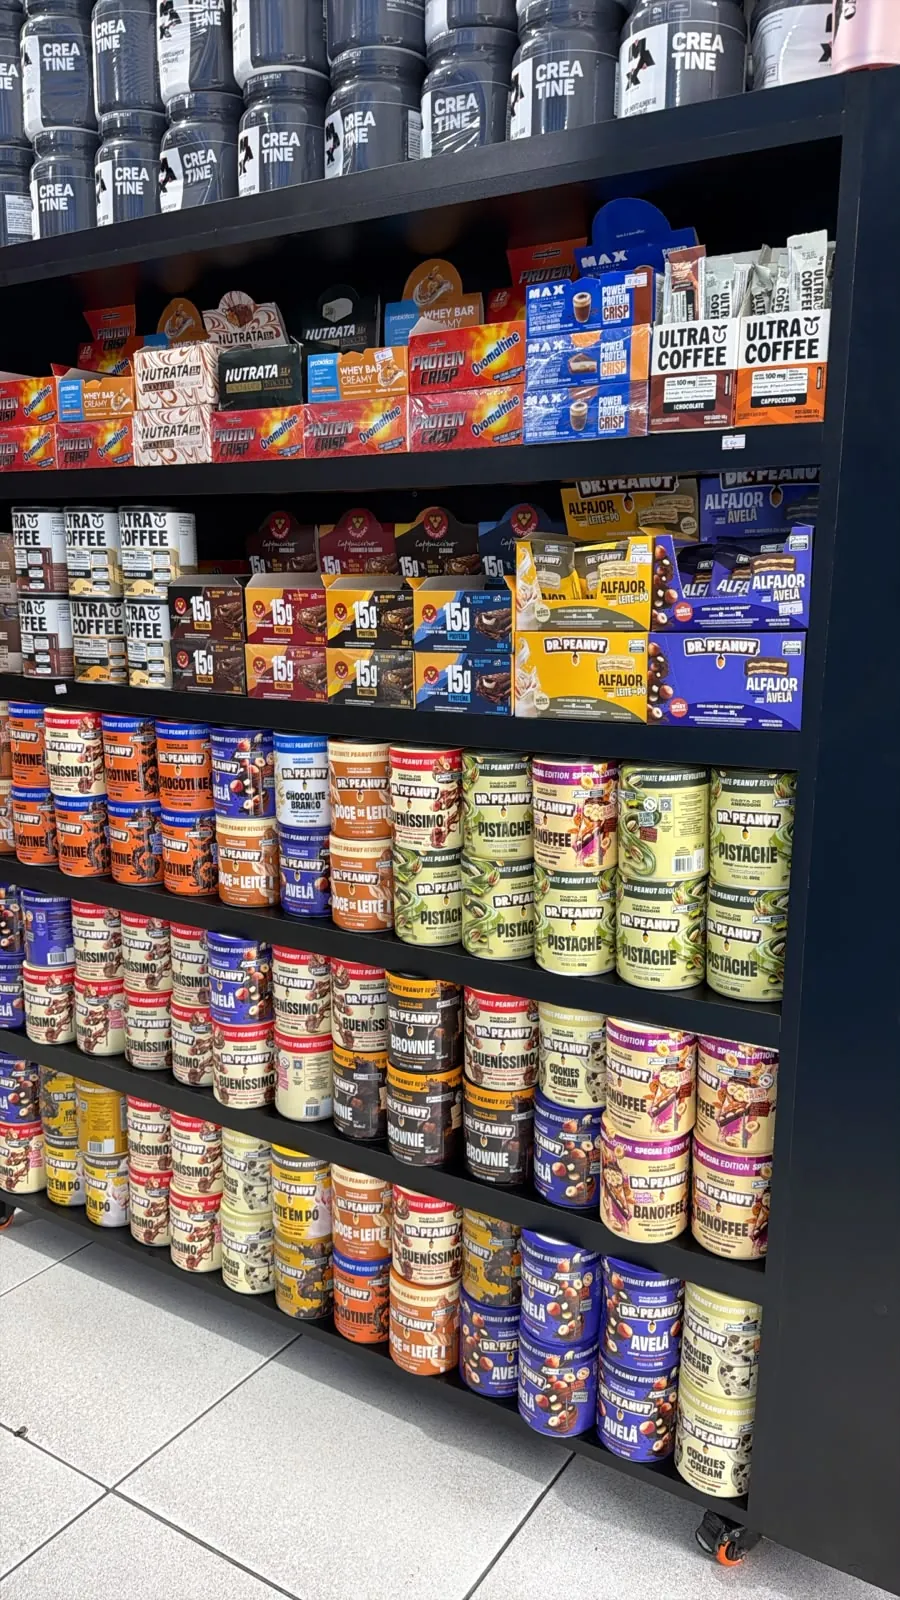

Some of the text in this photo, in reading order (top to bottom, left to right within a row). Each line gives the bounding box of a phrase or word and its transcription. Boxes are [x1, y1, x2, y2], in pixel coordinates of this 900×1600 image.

[96, 20, 126, 39] CREA
[43, 43, 80, 56] CREA
[672, 32, 724, 53] CREA
[43, 58, 75, 70] TINE
[672, 52, 716, 71] TINE
[536, 61, 583, 80] CREA
[536, 79, 575, 97] TINE
[435, 93, 478, 115] CREA
[344, 111, 376, 131] CREA
[262, 132, 300, 147] CREA
[344, 128, 369, 143] TINE
[183, 150, 217, 168] CREA
[262, 150, 294, 162] TINE
[115, 167, 149, 180] CREA
[186, 166, 212, 183] TINE
[39, 184, 74, 197] CREA
[115, 182, 143, 195] TINE
[40, 198, 68, 210] TINE
[581, 250, 628, 268] MAX
[529, 285, 565, 299] MAX
[602, 284, 626, 295] POWER
[603, 295, 629, 305] PROTEIN
[424, 305, 474, 319] WHEY BAR
[603, 306, 629, 320] CRISP
[306, 324, 355, 340] NUTRATA
[746, 318, 801, 340] ULTRA
[219, 331, 263, 344] NUTRATA
[659, 327, 709, 348] ULTRA
[601, 341, 623, 350] POWER
[745, 339, 818, 363] COFFEE
[411, 351, 464, 371] PROTEIN
[472, 332, 519, 376] Ovomaltine
[601, 351, 626, 361] PROTEIN
[658, 347, 726, 370] COFFEE
[142, 365, 189, 381] NUTRATA
[225, 365, 278, 382] NUTRATA
[340, 364, 381, 375] WHEY BAR
[602, 363, 625, 374] CRISP
[341, 375, 372, 385] CREAMY
[421, 370, 459, 385] CRISP
[472, 396, 519, 437] Ovomaltine
[600, 418, 624, 429] CRISP
[142, 425, 189, 438] NUTRATA
[261, 415, 298, 449] Ovomaltine
[358, 406, 400, 444] Ovomaltine
[569, 501, 616, 514] ALFAJOR
[705, 492, 763, 509] ALFAJOR
[601, 581, 645, 593] ALFAJOR
[753, 574, 805, 589] ALFAJOR
[618, 595, 633, 604] LEITE
[774, 587, 800, 601] AVELÃ
[73, 603, 108, 618] ULTRA
[190, 597, 211, 621] 15g
[271, 599, 293, 626] 15g
[353, 601, 378, 629] 15g
[444, 603, 470, 631] 15g
[73, 620, 123, 634] COFFEE
[545, 639, 605, 651] DR. PEANUT
[687, 640, 757, 653] DR. PEANUT
[193, 650, 213, 675] 15g
[272, 656, 294, 681] 15g
[354, 660, 378, 687] 15g
[446, 665, 471, 693] 15g
[599, 674, 642, 686] ALFAJOR
[746, 678, 797, 691] ALFAJOR
[616, 688, 632, 696] LEITE
[766, 691, 792, 702] AVELÃ
[169, 754, 204, 763] PEANUT
[294, 769, 327, 778] PEANUT
[349, 779, 387, 788] PEANUT
[286, 792, 325, 800] CHOCOLATE
[400, 787, 437, 798] PEANUT
[490, 794, 531, 803] PEANUT
[292, 801, 320, 809] BRANCO
[538, 801, 574, 814] PEANUT
[335, 805, 356, 820] DOCE
[717, 812, 779, 826] DR. PEANUT
[479, 821, 530, 836] PISTACHE
[229, 849, 260, 860] PEANUT
[719, 842, 777, 863] PISTACHE
[290, 859, 323, 870] PEANUT
[241, 875, 266, 888] LEITE
[345, 874, 377, 884] PEANUT
[286, 884, 313, 898] AVELÃ
[358, 901, 383, 913] LEITE
[562, 907, 602, 917] PEANUT
[634, 919, 678, 930] PEANUT
[717, 924, 759, 942] PEANUT
[549, 935, 601, 950] PISTACHE
[622, 944, 676, 965] PISTACHE
[708, 950, 757, 976] PISTACHE
[280, 977, 313, 987] PEANUT
[400, 1013, 439, 1024] PEANUT
[491, 1027, 531, 1037] PEANUT
[391, 1035, 435, 1054] BROWNIE
[552, 1041, 588, 1055] PEANUT
[235, 1053, 270, 1063] PEANUT
[473, 1052, 536, 1068] BUENÍSSIMO
[550, 1063, 580, 1078] COOKIES
[220, 1076, 274, 1089] BUENÍSSIMO
[397, 1103, 429, 1118] PEANUT
[475, 1122, 513, 1136] PEANUT
[467, 1142, 508, 1166] BROWNIE
[651, 1173, 685, 1186] PEANUT
[282, 1184, 315, 1195] PEANUT
[708, 1184, 753, 1204] PEANUT
[347, 1202, 382, 1213] PEANUT
[634, 1204, 684, 1219] BANOFFEE
[696, 1210, 748, 1237] BANOFFEE
[361, 1226, 386, 1242] LEITE
[421, 1225, 457, 1237] PEANUT
[402, 1245, 460, 1265] BUENÍSSIMO
[639, 1306, 679, 1317] PEANUT
[398, 1317, 434, 1332] PEANUT
[632, 1333, 669, 1351] AVELÃ
[611, 1393, 650, 1414] PEANUT
[604, 1417, 638, 1442] AVELÃ
[695, 1427, 740, 1449] PEANUT
[686, 1447, 725, 1469] COOKIES
